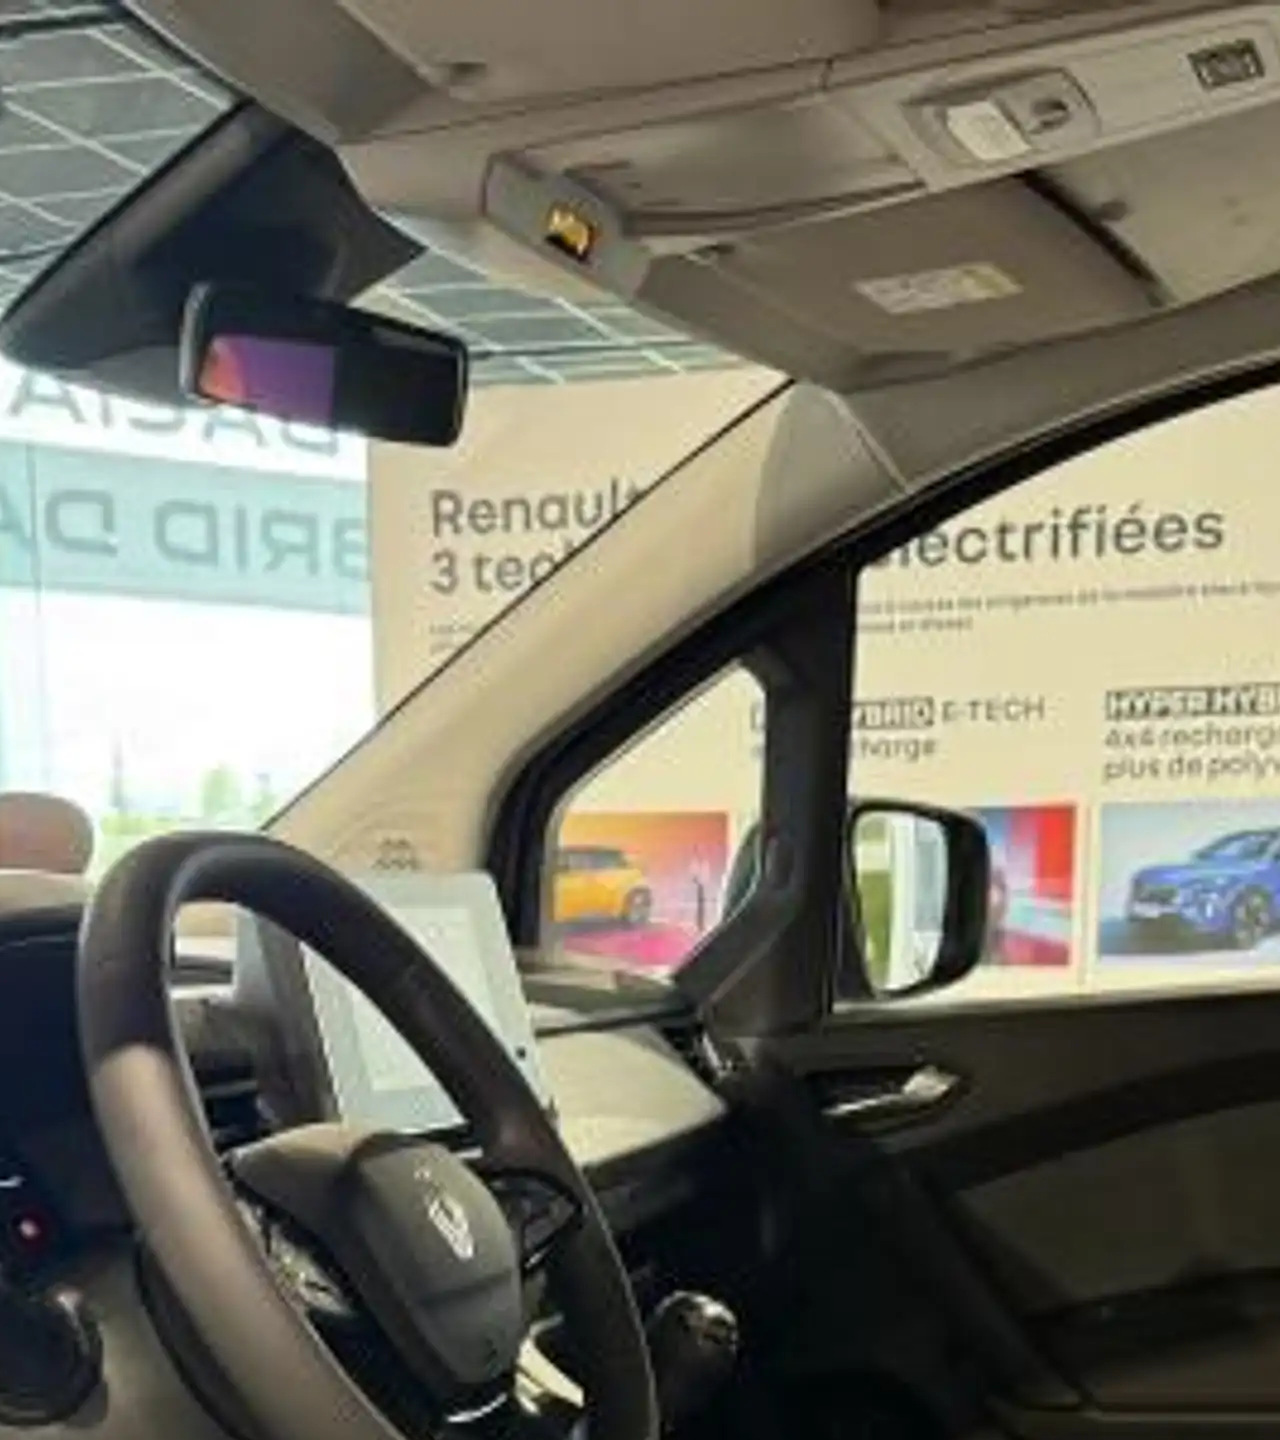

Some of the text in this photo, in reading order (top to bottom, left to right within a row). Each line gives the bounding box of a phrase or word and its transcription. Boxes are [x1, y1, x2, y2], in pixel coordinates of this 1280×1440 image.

[875, 501, 1222, 568] ectrifiées
[429, 540, 575, 596] 3 tec
[853, 695, 1045, 729] BRID E-TECH
[1108, 688, 1207, 718] HYPER
[858, 736, 937, 763] harge
[1104, 726, 1156, 748] 4x4
[1103, 756, 1160, 784] plus
[1167, 754, 1202, 780] de
